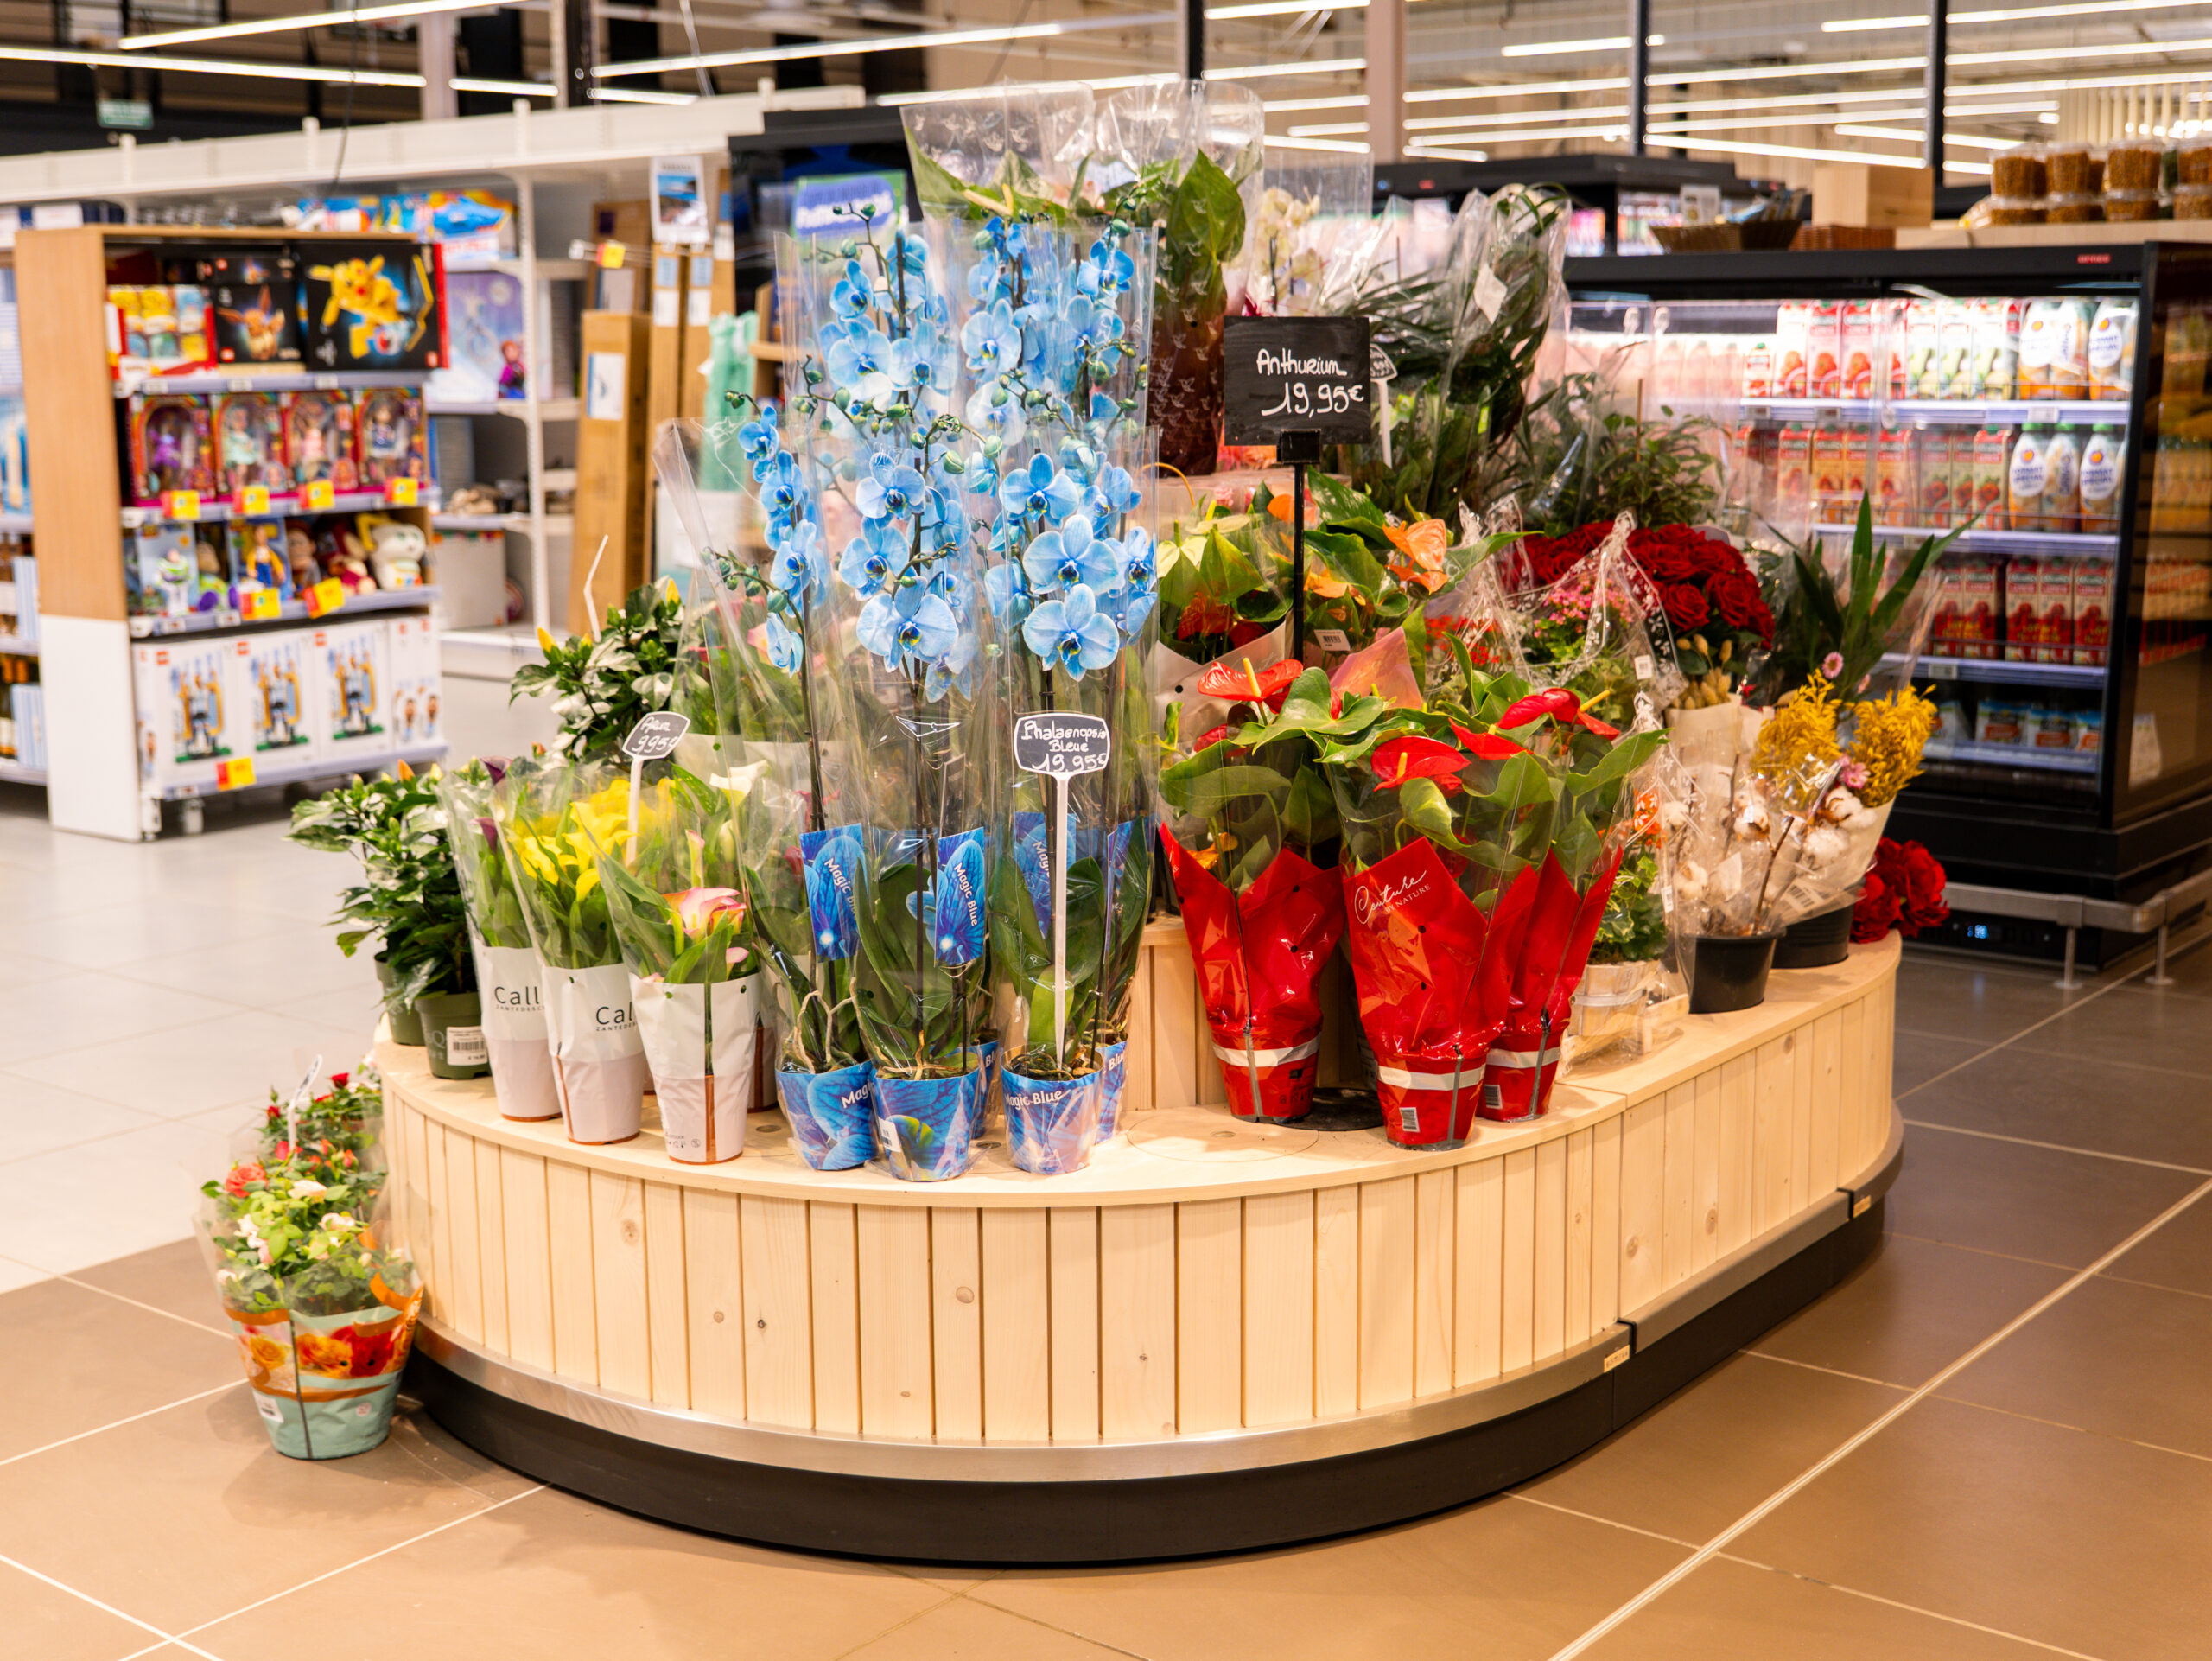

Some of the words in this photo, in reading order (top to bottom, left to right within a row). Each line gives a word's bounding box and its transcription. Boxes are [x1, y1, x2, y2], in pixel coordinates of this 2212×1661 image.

[1256, 347, 1348, 376] Anthurium
[1261, 382, 1364, 419] 19,95€
[1021, 719, 1107, 742] Phalaenopsis
[1032, 753, 1107, 773] 19,95€
[823, 857, 852, 894] Magic
[954, 862, 973, 899] Magic
[967, 899, 978, 927] Blue
[1395, 883, 1432, 908] NATURE
[985, 1050, 996, 1068] Bl
[1032, 1090, 1062, 1105] Blue
